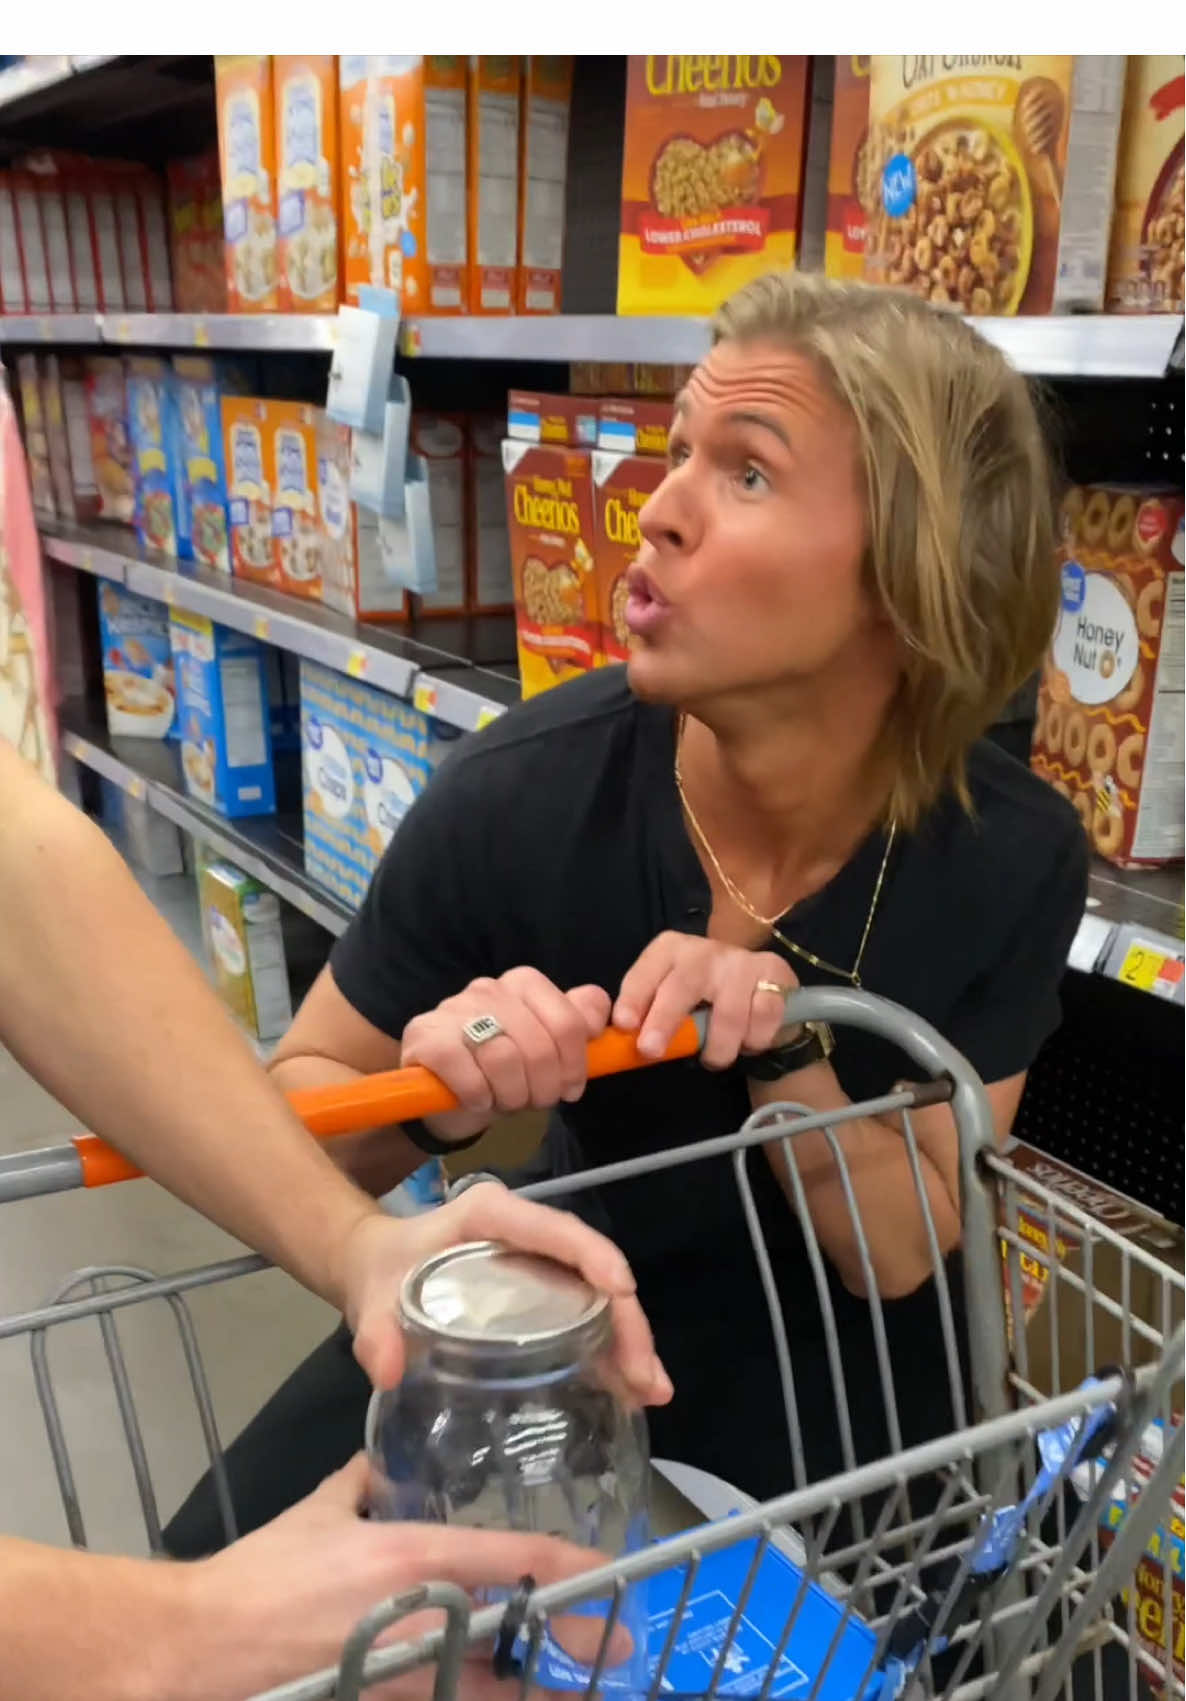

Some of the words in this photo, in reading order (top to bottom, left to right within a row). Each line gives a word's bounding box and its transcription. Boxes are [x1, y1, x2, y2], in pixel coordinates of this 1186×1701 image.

[884, 163, 914, 206] NEW
[514, 484, 581, 535] Cheerios
[1076, 616, 1125, 652] Honey
[1073, 643, 1097, 671] Nut
